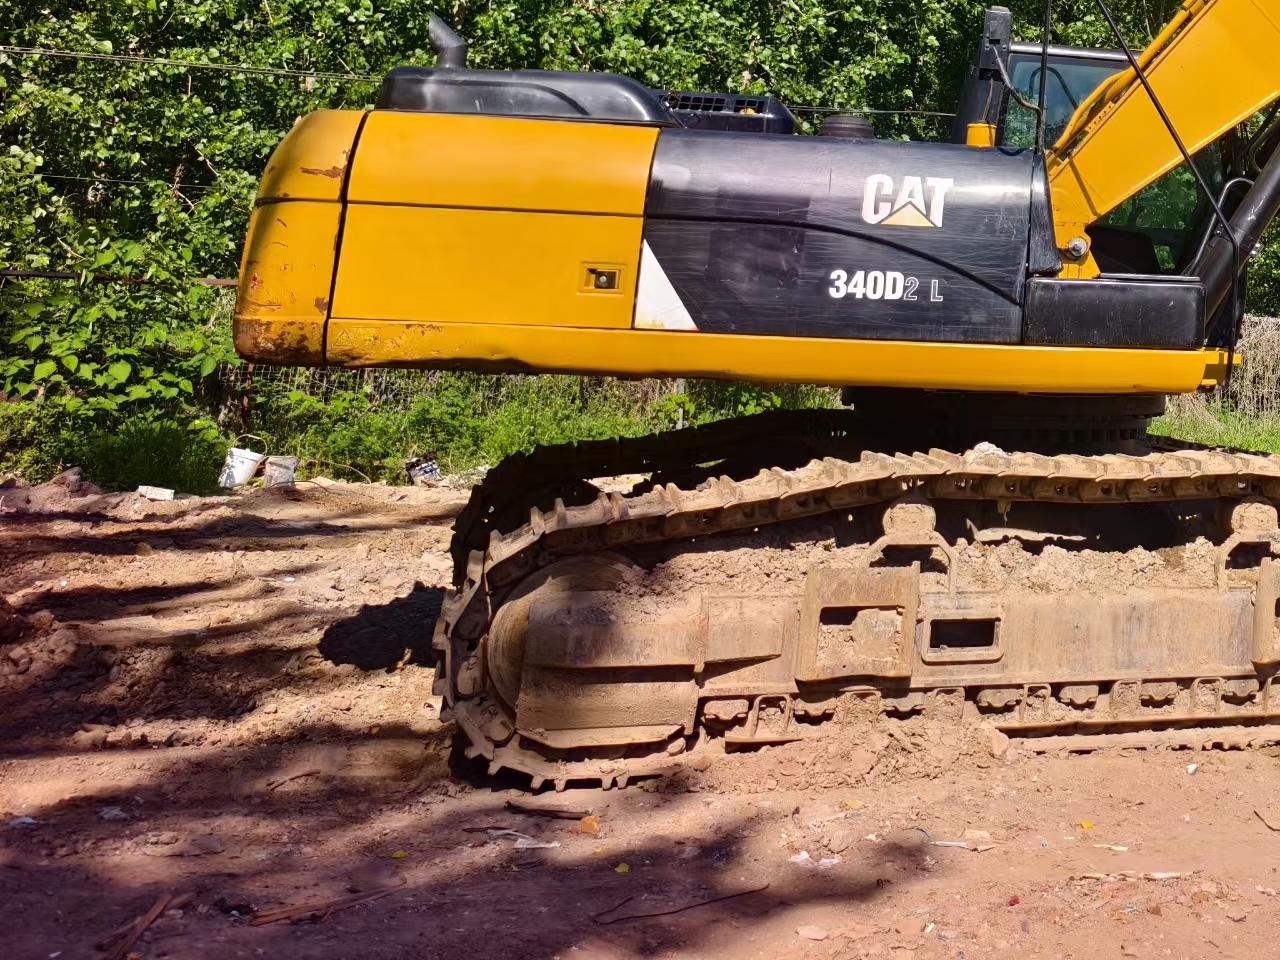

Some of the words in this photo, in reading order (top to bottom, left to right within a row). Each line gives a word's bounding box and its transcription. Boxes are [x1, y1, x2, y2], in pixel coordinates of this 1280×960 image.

[861, 173, 954, 228] CAT
[828, 269, 920, 302] 340D2
[930, 279, 944, 303] L
